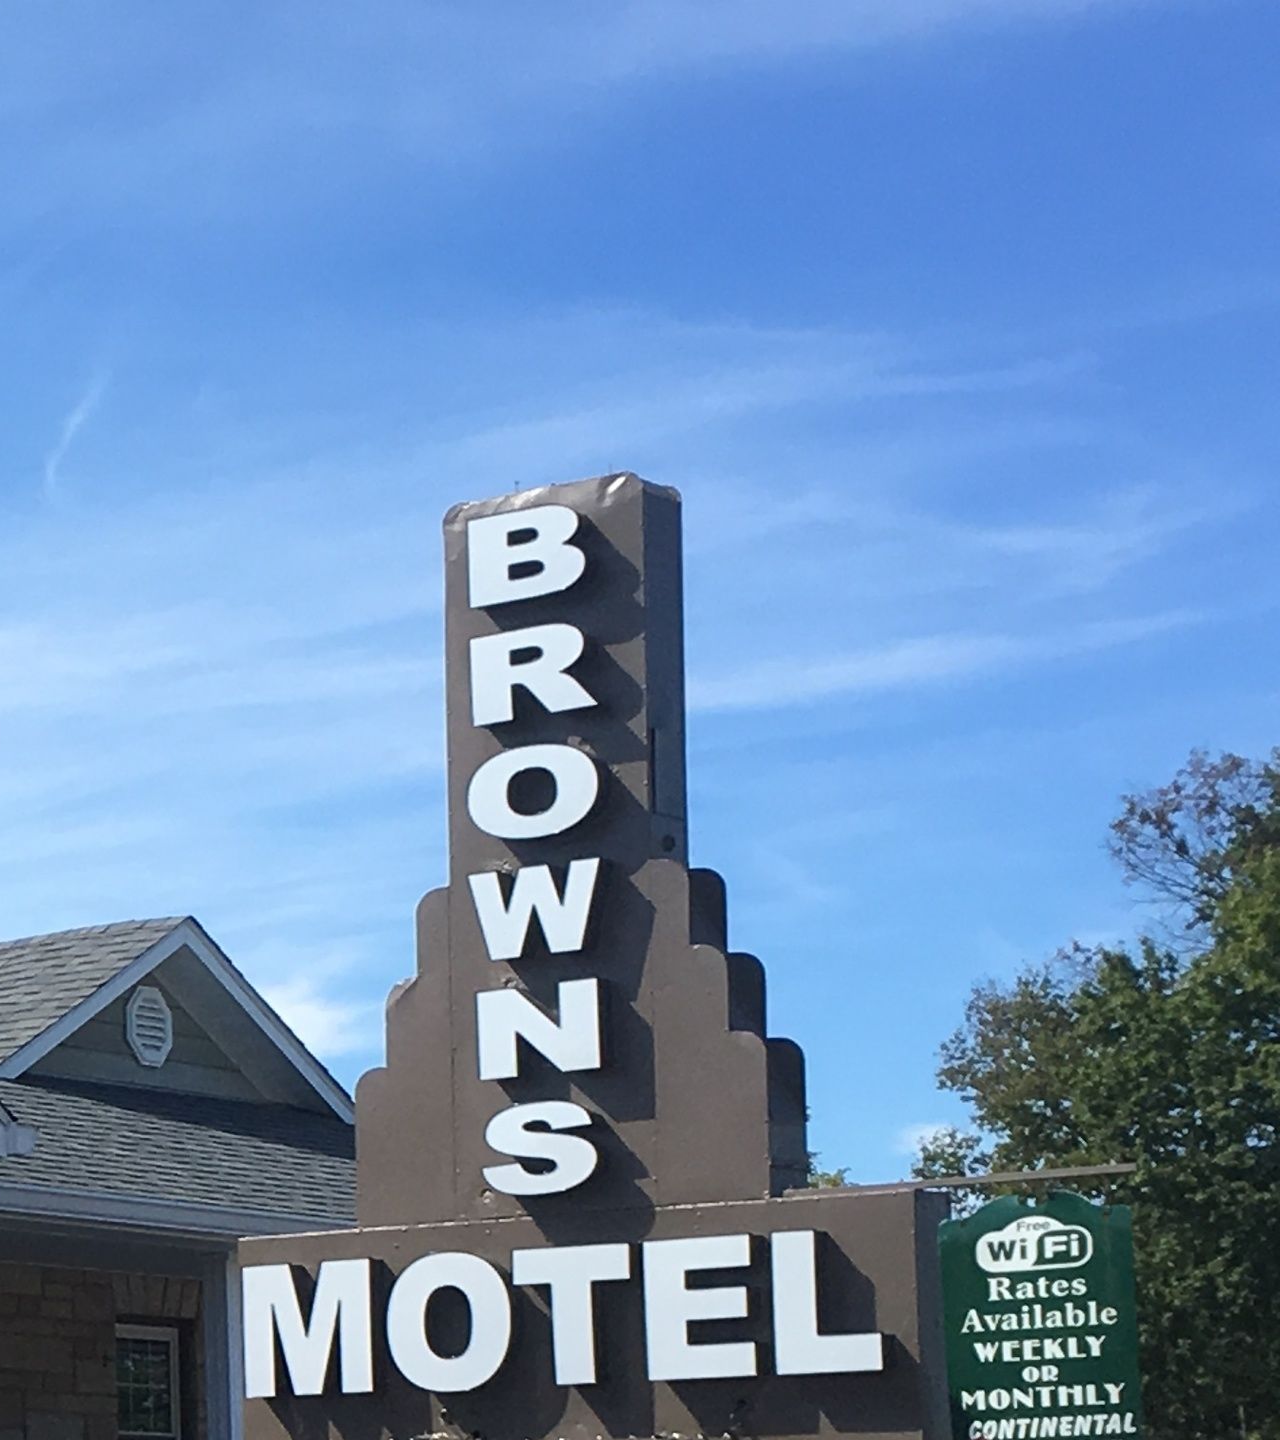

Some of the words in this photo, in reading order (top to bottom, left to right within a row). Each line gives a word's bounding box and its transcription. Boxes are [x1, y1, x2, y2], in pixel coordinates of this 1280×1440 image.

[467, 503, 599, 1197] BROWNS
[1016, 1220, 1051, 1233] Free
[987, 1277, 1088, 1302] Rates
[241, 1230, 884, 1399] MOTEL
[960, 1301, 1119, 1334] Available
[973, 1335, 1107, 1363] WEEKLY
[1021, 1365, 1059, 1383] OR
[960, 1383, 1126, 1411] MONTHLY
[968, 1412, 1137, 1440] CONTINENTAL
